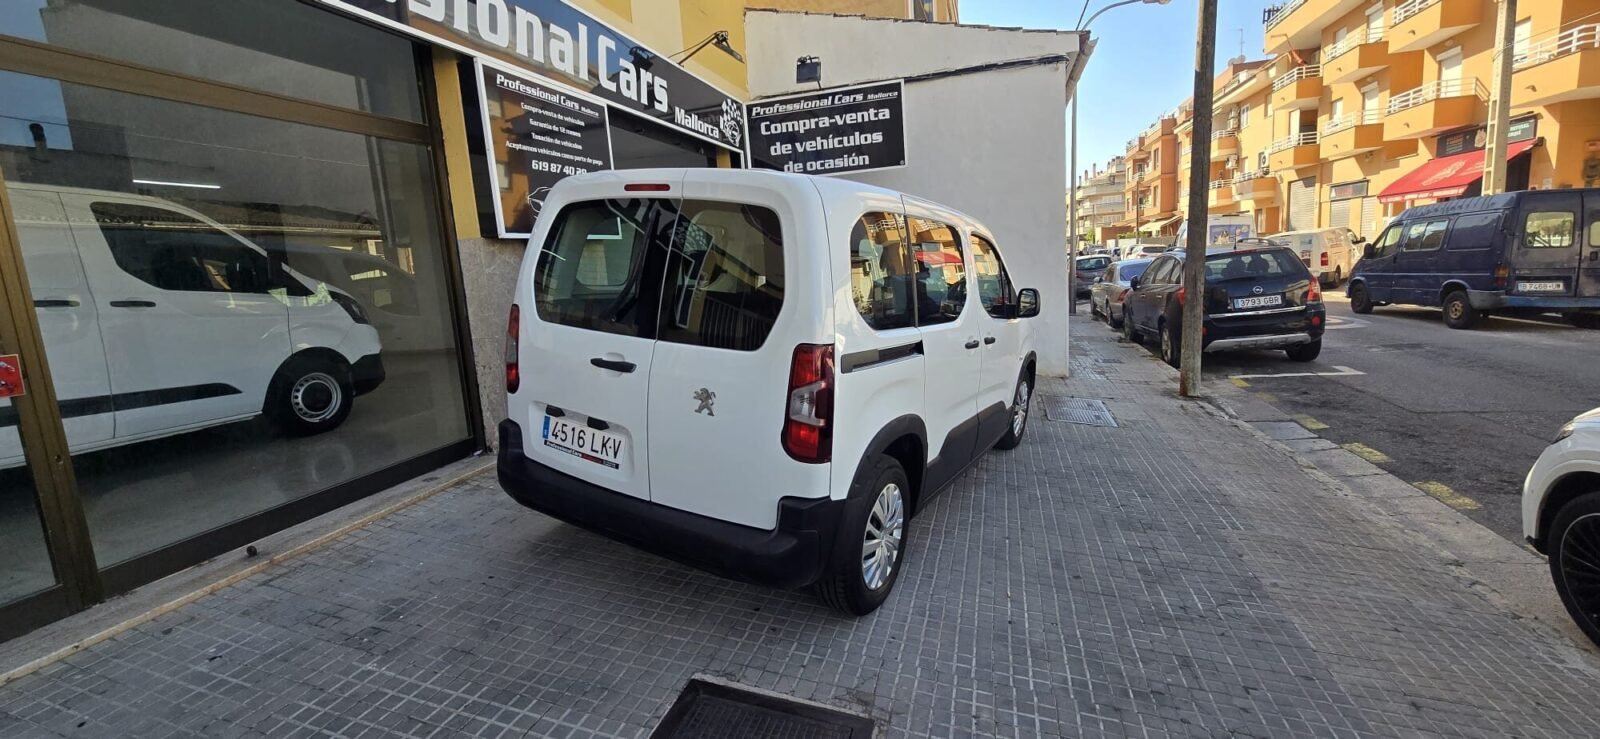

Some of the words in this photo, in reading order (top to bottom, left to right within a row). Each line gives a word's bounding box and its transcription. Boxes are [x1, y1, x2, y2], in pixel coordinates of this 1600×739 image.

[597, 34, 669, 113] Cars
[496, 73, 559, 104] Professional
[560, 95, 580, 110] Cars
[751, 97, 832, 117] Professional
[834, 93, 864, 105] Cars
[866, 91, 898, 100] Mallorca
[520, 102, 557, 119] Compra-venta
[674, 106, 720, 140] Mallorca
[760, 107, 891, 136] Compra-venta
[559, 126, 566, 134] 12
[565, 130, 582, 138] meses
[770, 141, 793, 156] de
[794, 131, 884, 151] vehículos
[505, 140, 538, 153] Aceptamos
[574, 154, 587, 163] parte
[783, 160, 804, 173] de
[806, 152, 870, 172] ocasión
[531, 159, 549, 172] 619
[550, 163, 562, 174] 87
[563, 165, 575, 176] 40
[1240, 298, 1262, 307] 3793
[1263, 296, 1279, 305] GBR
[551, 421, 586, 449] 4516
